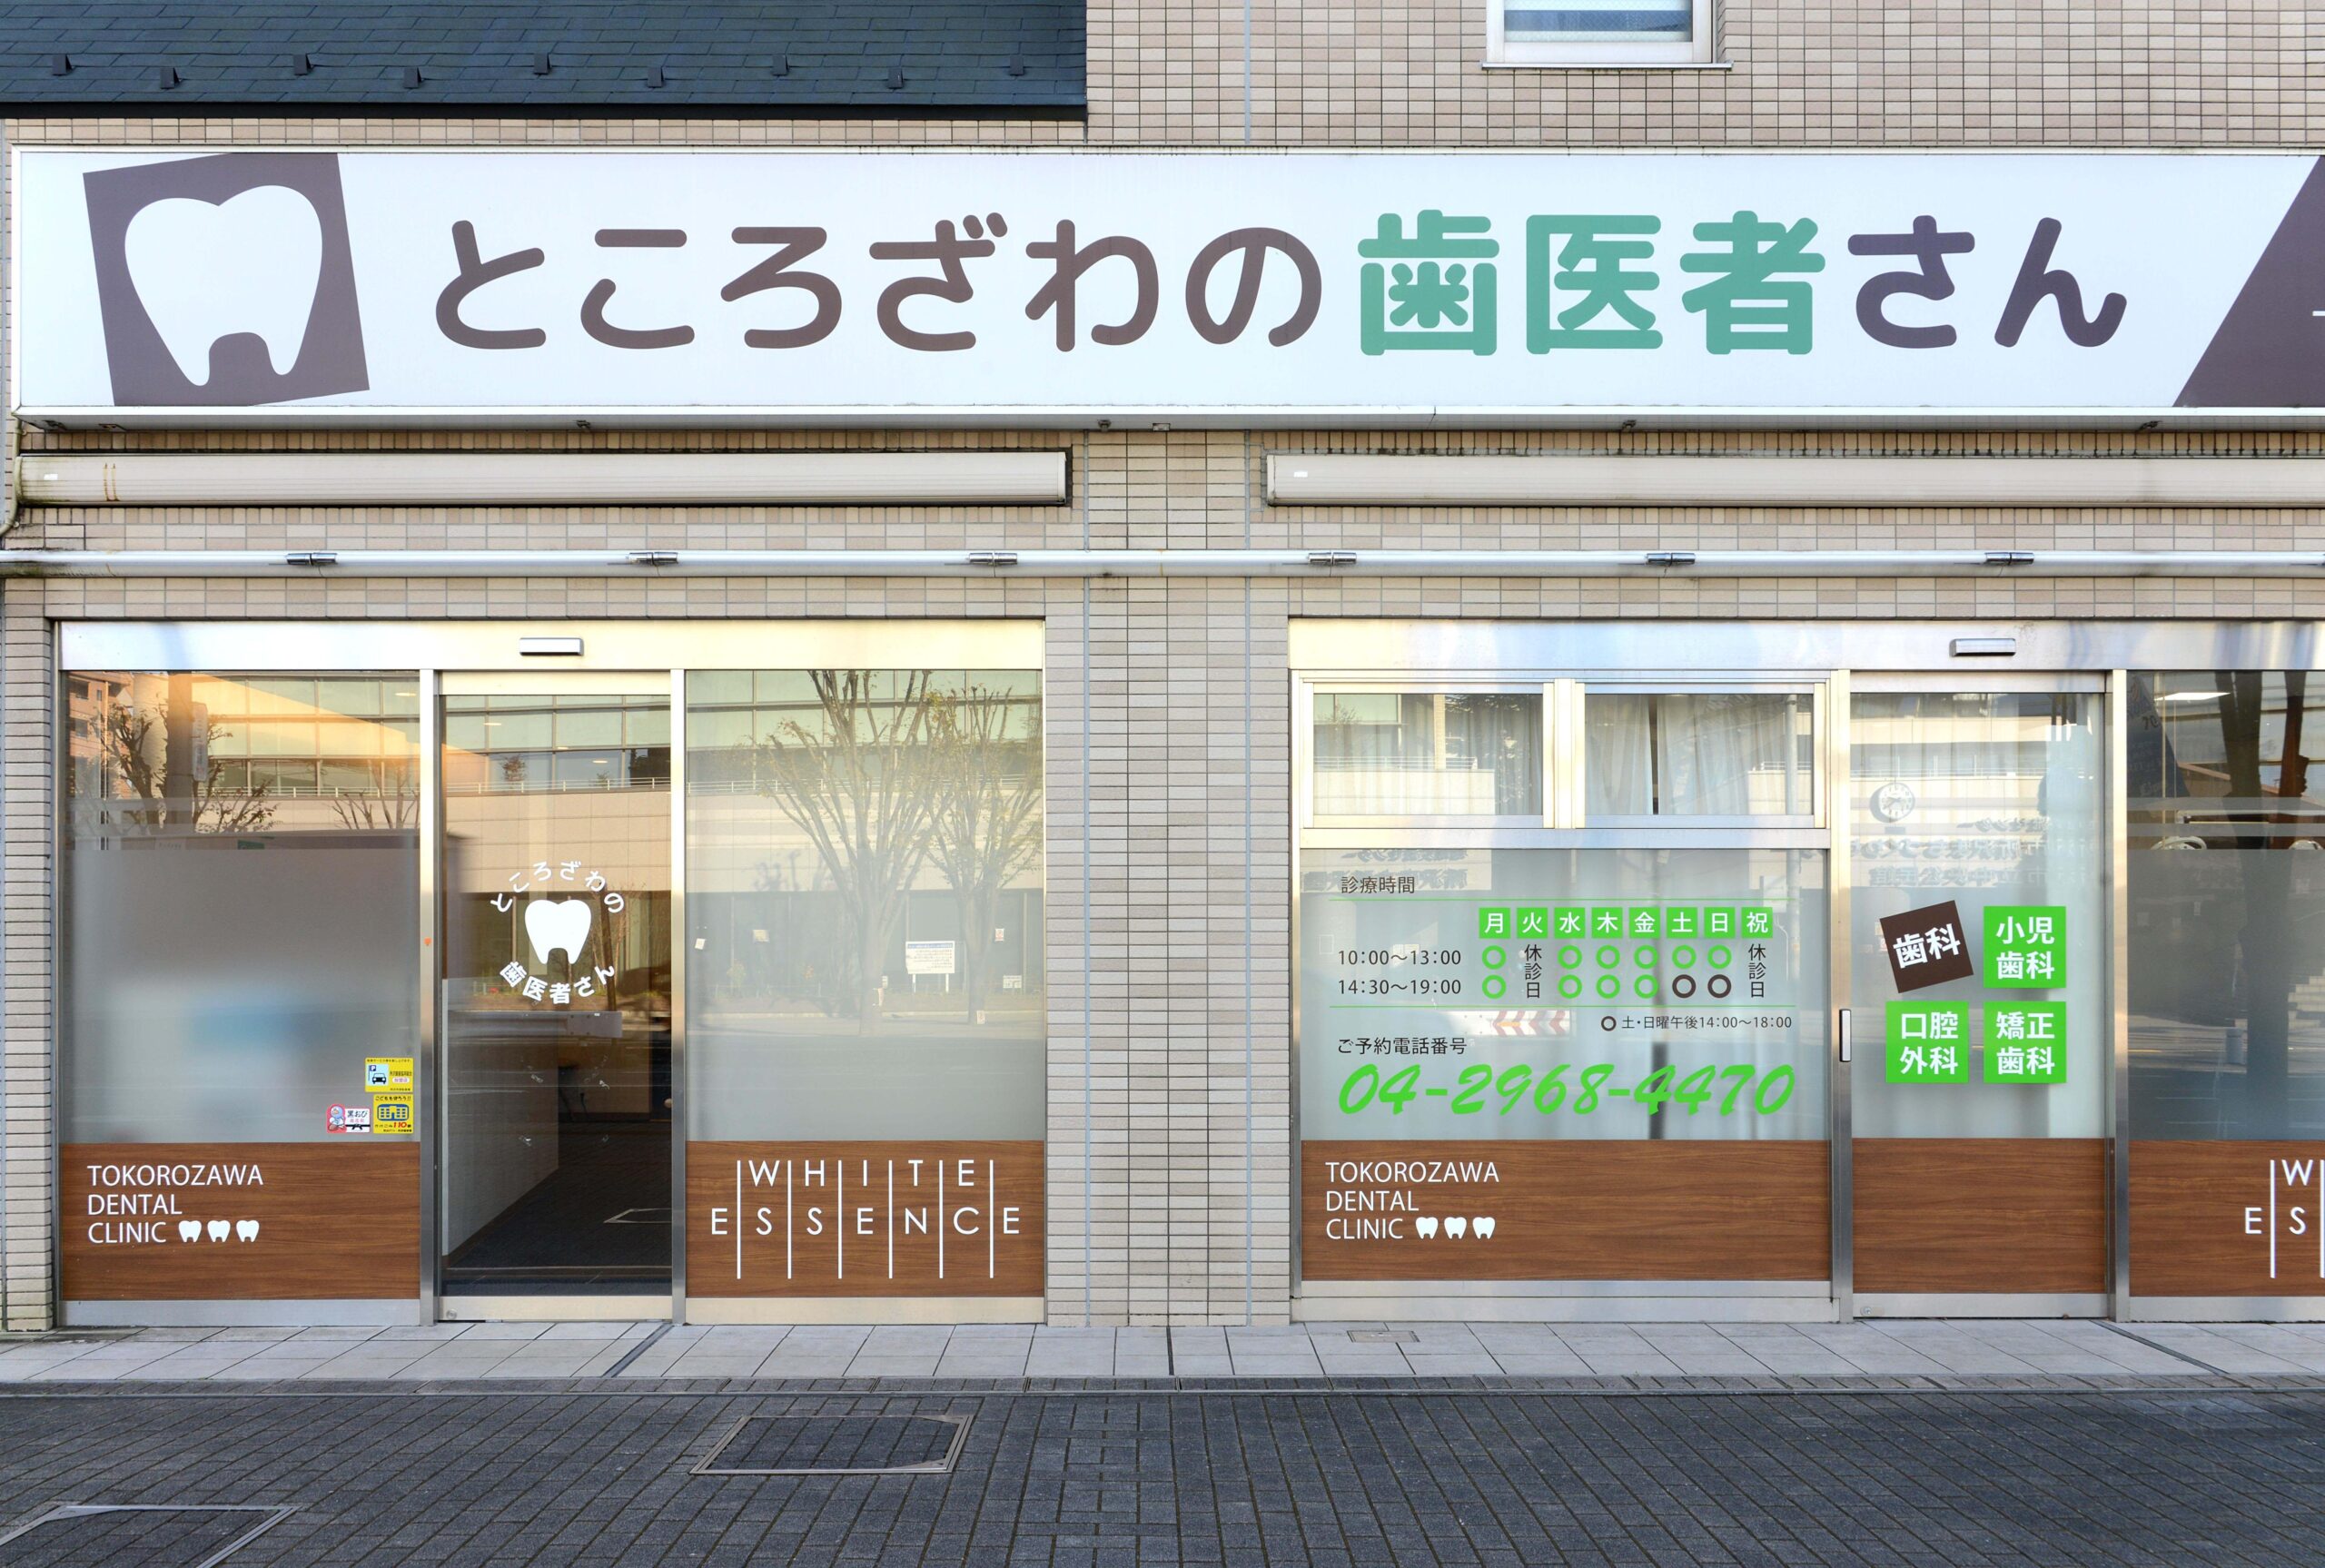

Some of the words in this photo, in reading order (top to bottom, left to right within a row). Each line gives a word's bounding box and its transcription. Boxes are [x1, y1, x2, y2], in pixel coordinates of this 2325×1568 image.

[436, 208, 2127, 358] ところざわの歯医者さん
[490, 860, 625, 913] ところざわの
[1341, 875, 1415, 894] 診療時間
[1484, 912, 1504, 934] 月
[1522, 912, 1544, 934] 火
[1558, 912, 1581, 934] 水
[1597, 912, 1618, 934] 木
[1634, 912, 1656, 934] 金
[1672, 912, 1693, 934] 土
[1712, 912, 1727, 934] 日
[1746, 912, 1768, 934] 祝
[1996, 916, 2055, 945] 小児
[1893, 923, 1961, 969] 歯科
[1524, 944, 1543, 999] 休診日
[1748, 943, 1766, 998] 休診日
[1996, 951, 2055, 980] 歯科
[500, 961, 615, 1004] 歯医者さん
[1901, 1011, 1958, 1040] 口腔
[1996, 1011, 2055, 1040] 矯正
[1337, 1036, 1468, 1055] ご予約電話番号
[1900, 1046, 1958, 1075] 外科
[1996, 1046, 2055, 1075] 歯科
[1338, 1063, 1796, 1116] 04-2968-4470
[87, 1164, 264, 1187] TOKOROZAWA
[748, 1159, 975, 1187] WHITE
[1326, 1162, 1500, 1183] TOKOROZAWA
[87, 1194, 183, 1215] DENTAL
[1326, 1191, 1420, 1211] DENTAL
[87, 1221, 167, 1244] CLINIC
[711, 1207, 1021, 1236] ESSENCE
[1326, 1218, 1404, 1240] CLINIC
